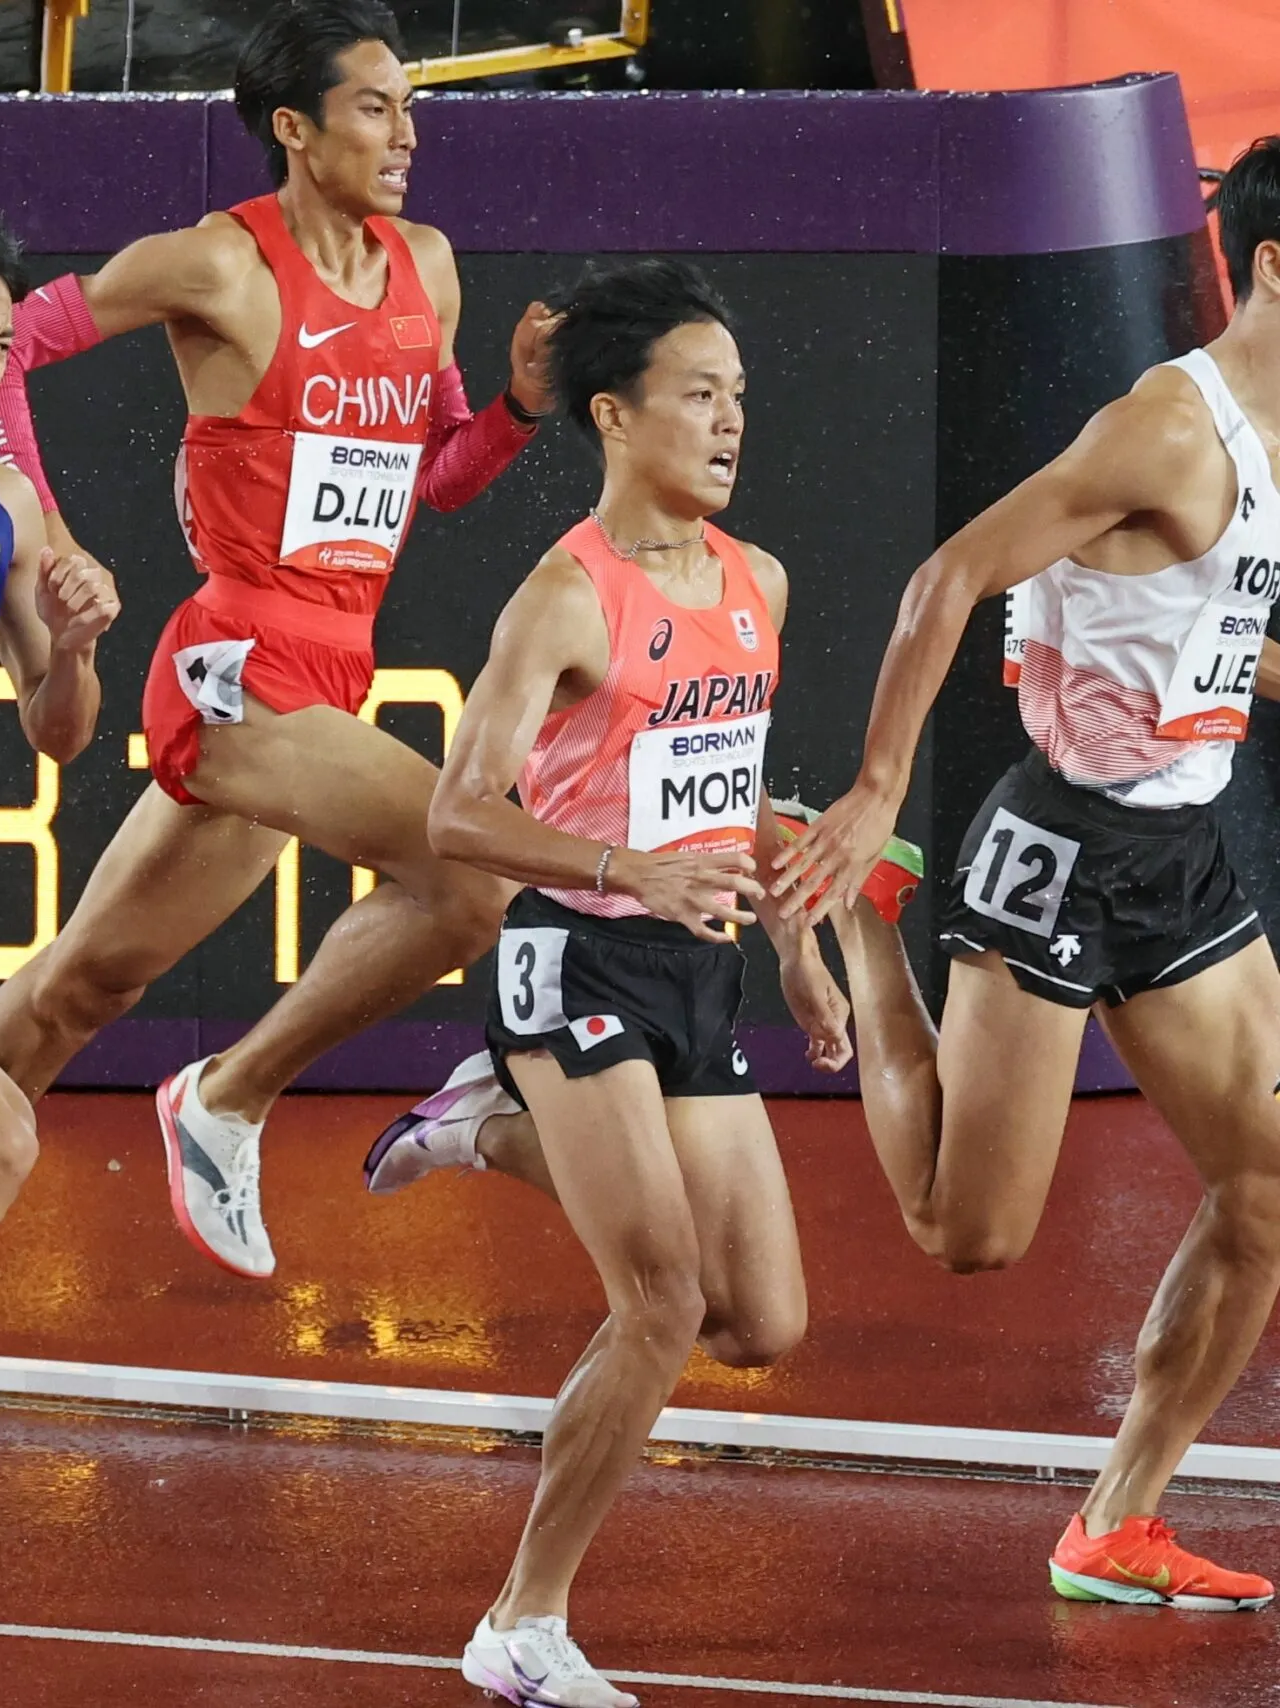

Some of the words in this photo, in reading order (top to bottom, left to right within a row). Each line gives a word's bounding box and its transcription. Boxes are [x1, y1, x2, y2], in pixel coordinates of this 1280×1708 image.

[302, 373, 432, 426] CHINA
[330, 446, 410, 470] BORNAN
[313, 482, 406, 529] D.LIU
[1220, 616, 1266, 636] BORN
[648, 672, 772, 726] JAPAN
[1194, 654, 1257, 694] J.LE
[669, 725, 755, 756] BORNAN
[661, 764, 757, 820] MORI
[979, 828, 1057, 922] 12
[512, 942, 536, 1021] 3
